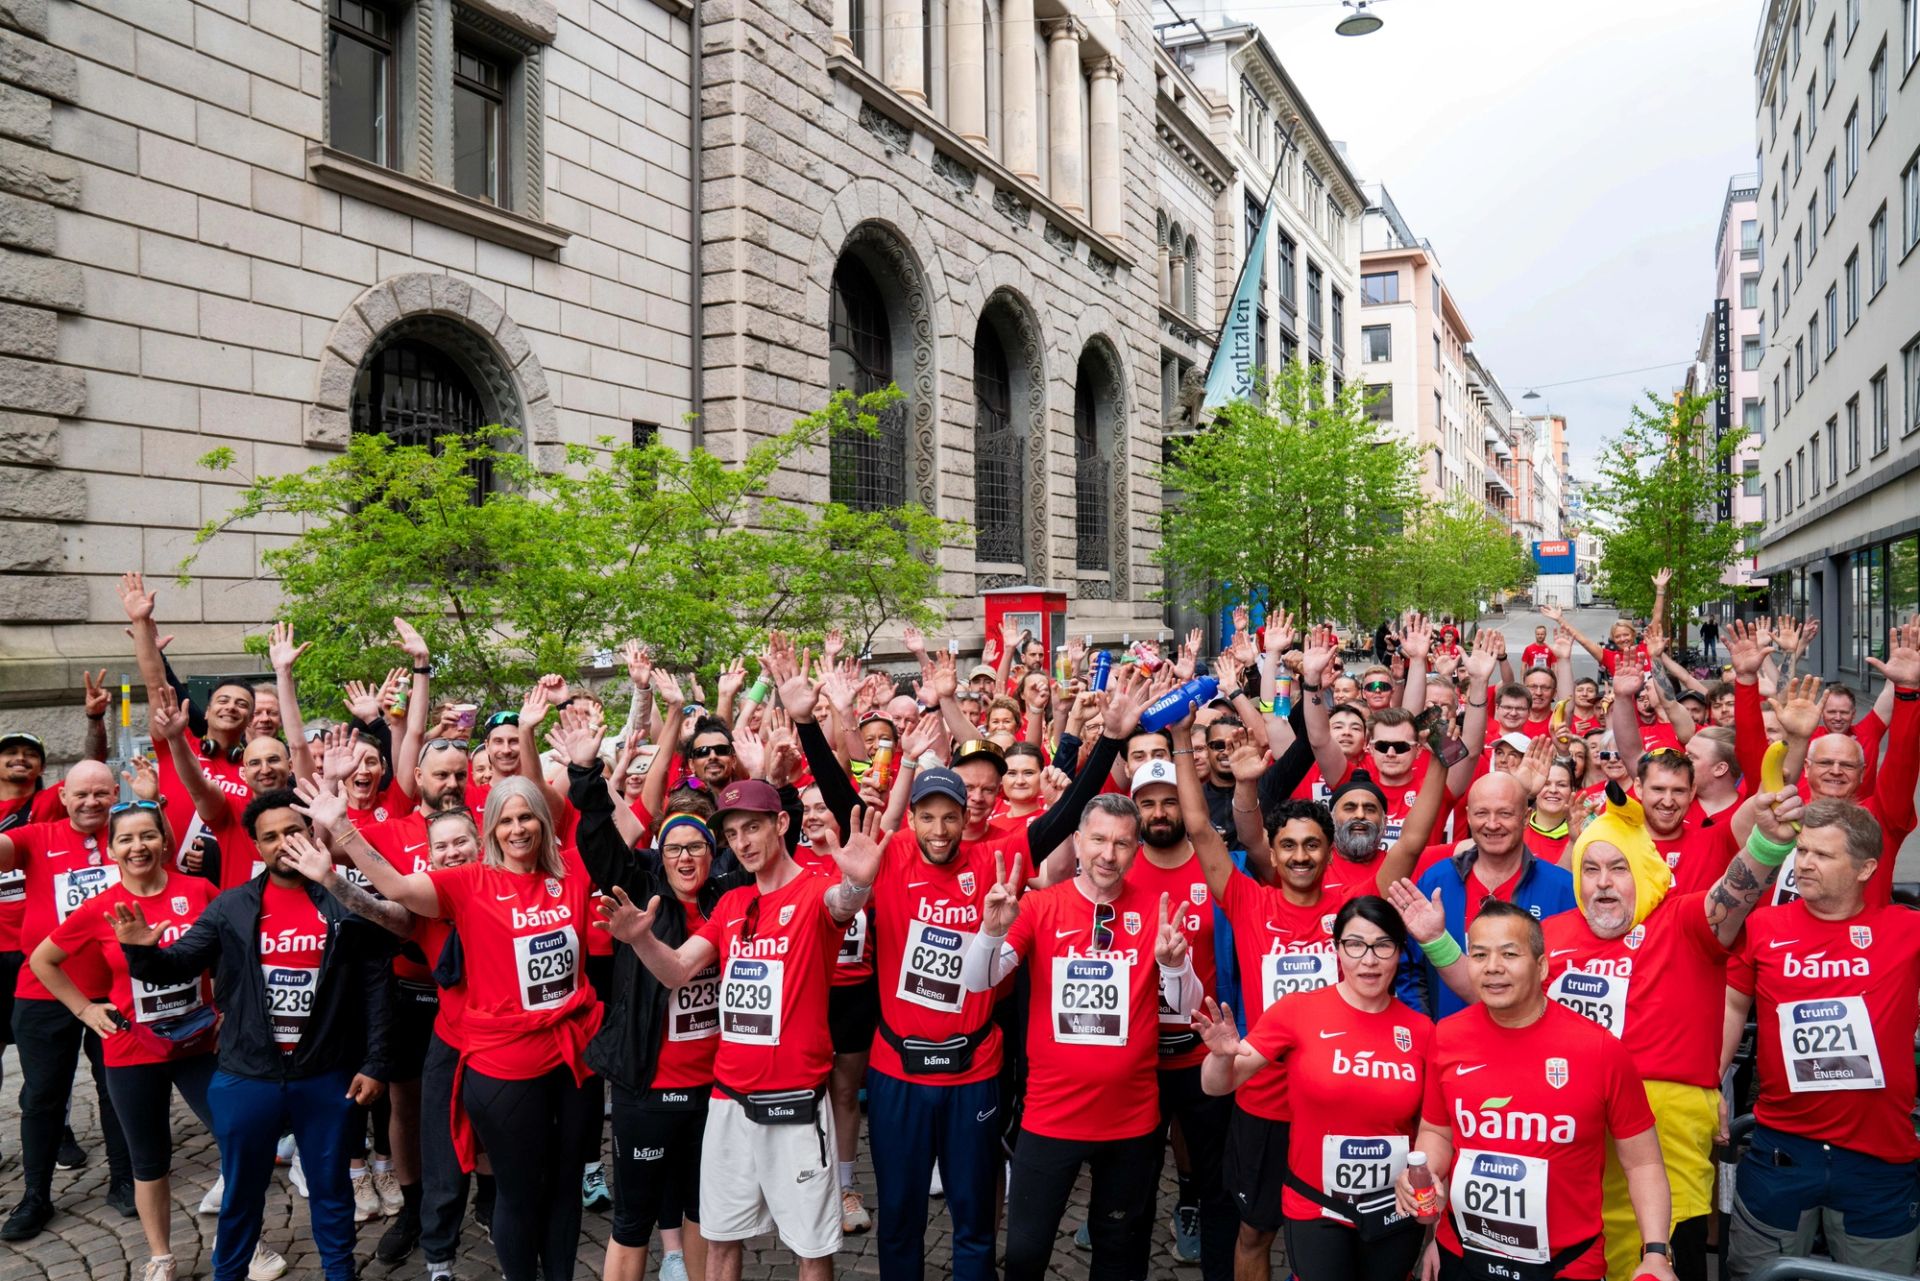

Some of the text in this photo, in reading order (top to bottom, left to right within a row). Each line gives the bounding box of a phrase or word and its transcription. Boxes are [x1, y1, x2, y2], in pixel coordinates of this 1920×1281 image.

[1230, 298, 1251, 397] Sentralen
[1719, 365, 1727, 415] HOTEL
[535, 935, 563, 950] trumf
[927, 931, 957, 947] trumf
[527, 949, 574, 981] 6239
[911, 946, 962, 979] 6239
[1282, 959, 1316, 971] trumf
[734, 965, 763, 977] trumf
[1074, 965, 1108, 976] trumf
[275, 973, 306, 983] trumf
[917, 977, 924, 987] Å
[916, 986, 945, 1000] ENERGI
[1567, 979, 1603, 993] trumf
[265, 988, 314, 1012] 6239
[725, 983, 772, 1010] 6239
[1062, 983, 1119, 1010] 6239
[156, 999, 188, 1011] ENERGI
[1799, 1004, 1840, 1019] trumf
[689, 1014, 696, 1023] Å
[732, 1014, 738, 1024] Å
[1073, 1014, 1079, 1025] Å
[732, 1024, 758, 1034] ENERGI
[1072, 1025, 1106, 1034] ENERGI
[1792, 1023, 1858, 1055] 6221
[1813, 1059, 1821, 1070] Å
[1814, 1069, 1854, 1080] ENERGI
[1347, 1142, 1384, 1155] trumf
[1479, 1159, 1519, 1176] trumf
[1335, 1163, 1391, 1189] 6211
[1464, 1180, 1526, 1219] 6211
[1481, 1227, 1520, 1246] ENERGI
